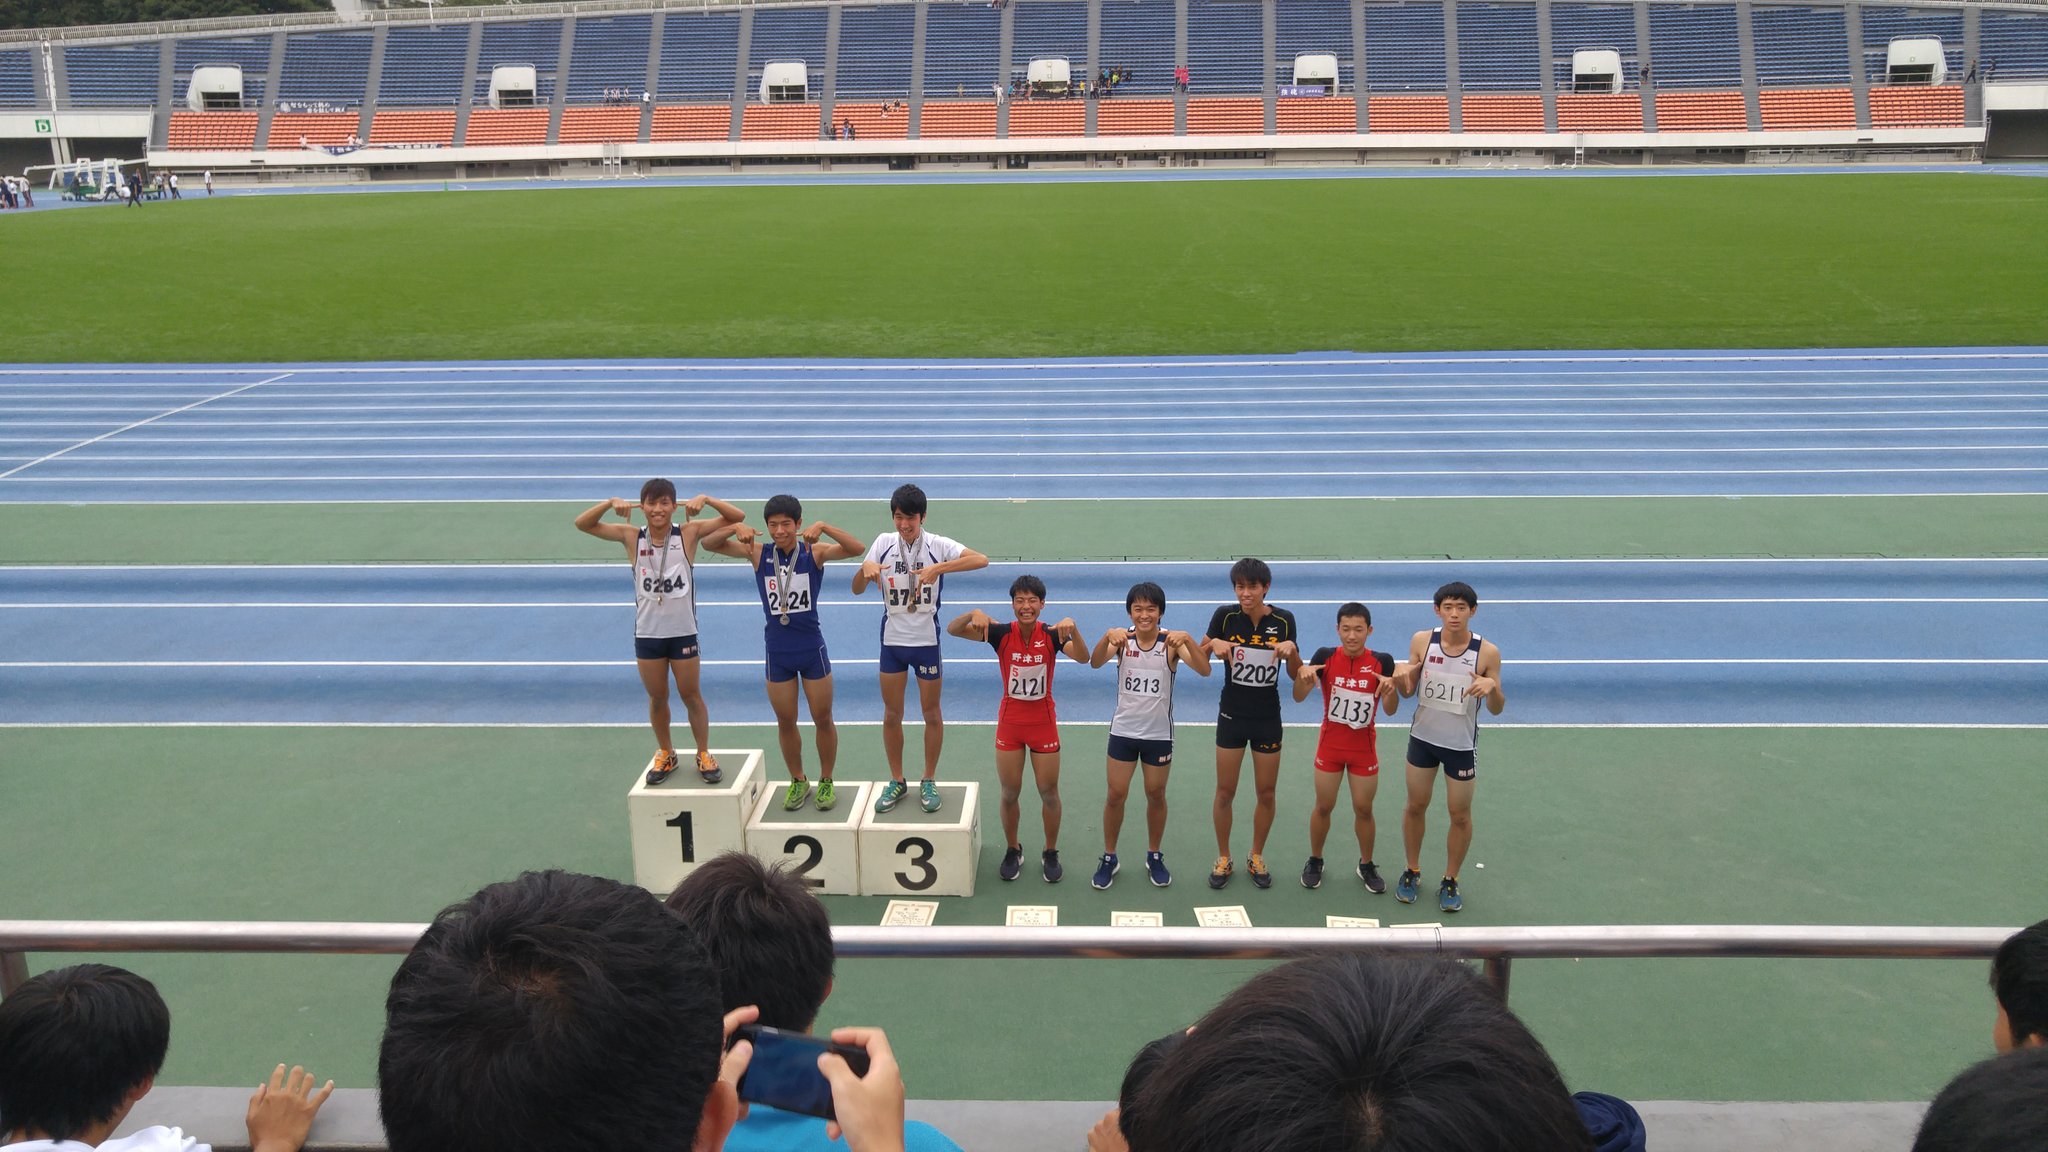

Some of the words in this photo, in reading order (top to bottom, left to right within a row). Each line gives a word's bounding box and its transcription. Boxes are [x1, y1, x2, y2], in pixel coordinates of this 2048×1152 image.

[38, 123, 48, 132] D
[643, 575, 685, 594] 6284
[769, 579, 777, 591] 6
[769, 590, 810, 611] 224
[1011, 652, 1043, 663] 野津田
[1236, 648, 1245, 661] 6
[1012, 668, 1019, 677] 5
[1232, 662, 1278, 684] 2202
[1011, 676, 1045, 696] 2121
[1125, 677, 1160, 694] 6213
[1334, 676, 1369, 689] 野津田
[1424, 680, 1465, 704] 6211
[1330, 696, 1372, 724] 2133
[666, 811, 695, 863] 1
[783, 834, 826, 888] 2
[894, 836, 938, 891] 3
